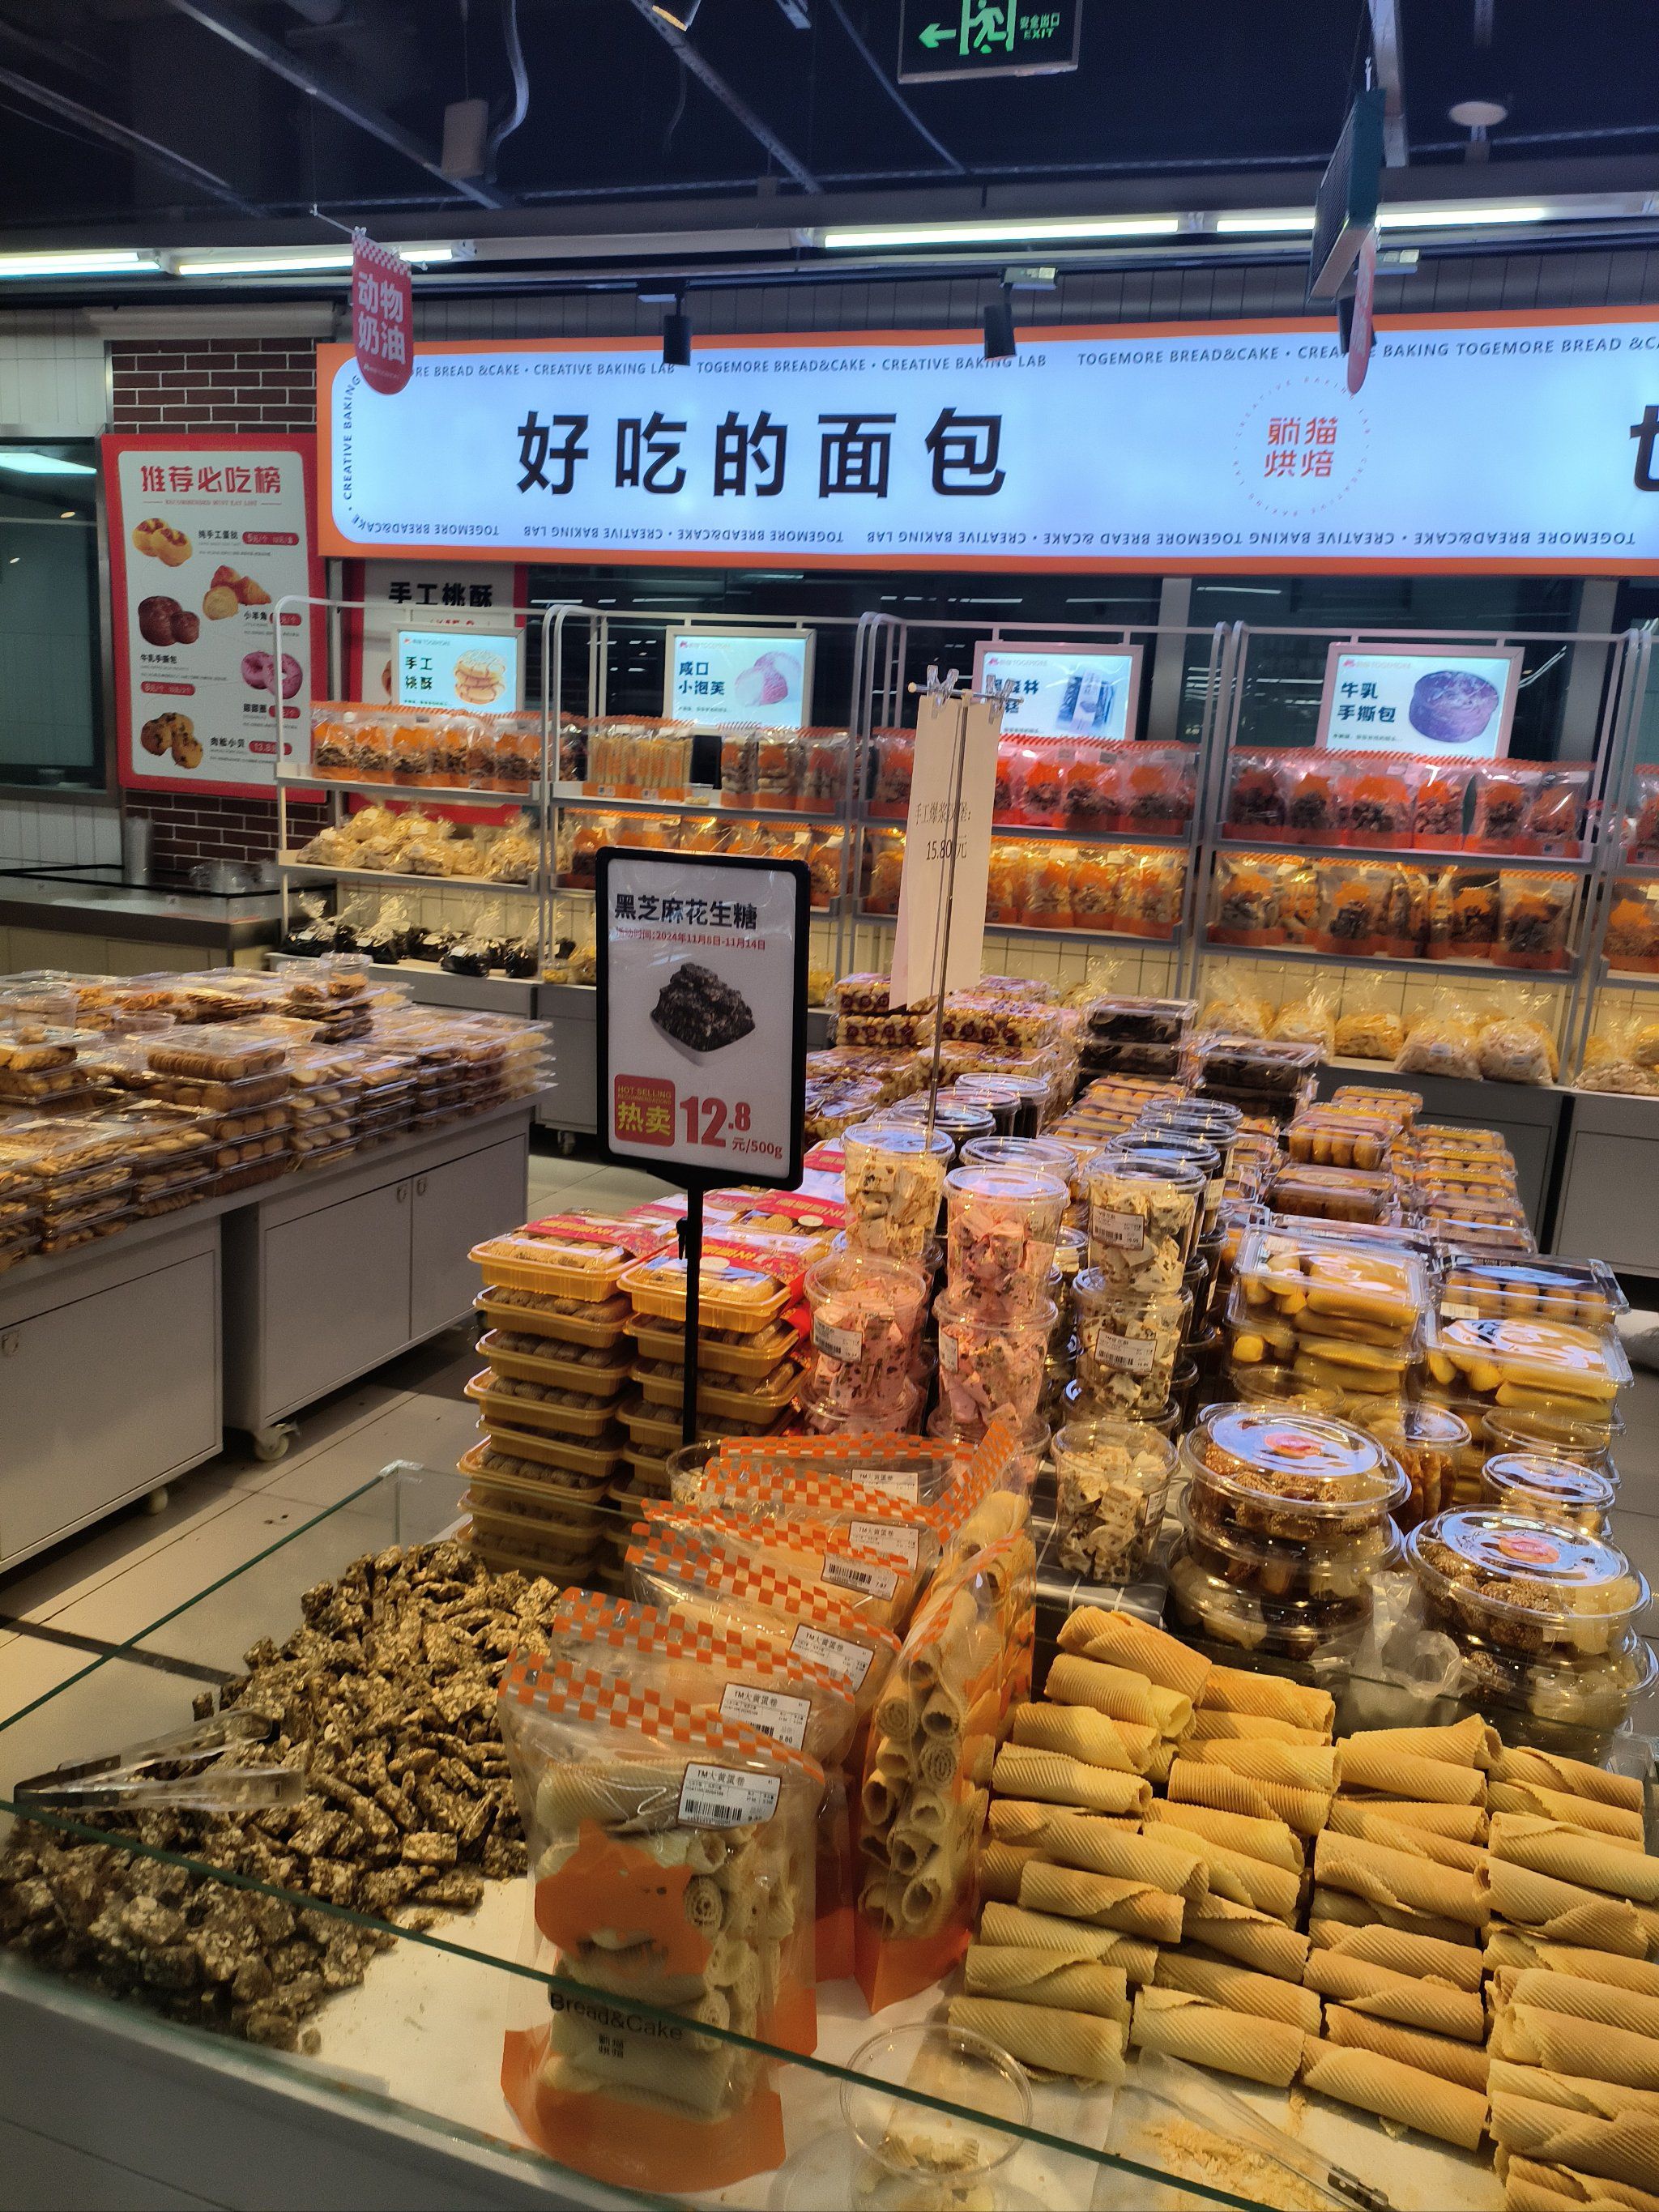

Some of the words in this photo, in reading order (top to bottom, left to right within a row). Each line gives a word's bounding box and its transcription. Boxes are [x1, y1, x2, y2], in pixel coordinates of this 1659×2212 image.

[1024, 28, 1055, 40] EXIT
[357, 271, 403, 323] 动物
[357, 314, 406, 365] 奶油
[1456, 339, 1555, 356] TOGEMORE
[1560, 337, 1622, 353] BREAD
[1077, 350, 1163, 365] TOGEMORE
[1169, 346, 1279, 363] BREAD&CAKE
[1383, 342, 1448, 358] BAKING
[433, 365, 474, 377] BREAD
[479, 364, 520, 376] &CAKE
[534, 363, 593, 376] CREATIVE
[597, 362, 646, 374] BAKING
[650, 363, 675, 374] LAB
[696, 360, 770, 373] TOGEMORE
[774, 359, 866, 373] BREAD&CAKE
[881, 357, 950, 371] CREATIVE
[1018, 355, 1047, 368] LAB
[343, 374, 361, 429] BAKING
[516, 407, 1006, 500] 好吃的面包
[343, 435, 352, 501] CREATIVE
[1264, 450, 1335, 478] 烘焙
[140, 466, 281, 493] 推荐必吃榜
[434, 523, 500, 536] TOGEMORE
[523, 525, 548, 537] LAB
[551, 526, 599, 539] BAKING
[603, 527, 663, 540] CREATIVE
[677, 528, 766, 542] BREAD&CAKE
[769, 530, 845, 543] TOGEMORE
[867, 531, 893, 543] LAB
[898, 531, 953, 543] BAKING
[958, 531, 1027, 544] CREATIVE
[1099, 532, 1150, 545] BREAD
[1156, 532, 1243, 545] TOGEMORE
[1248, 531, 1311, 545] BAKING
[1316, 531, 1395, 545] CREATIVE
[1414, 531, 1531, 545] BREAD&CAKE
[1537, 531, 1636, 545] TOGEMORE
[388, 582, 493, 607] 手工桃酥
[405, 656, 433, 671] 手工
[679, 680, 726, 696] 小泡芙
[1341, 682, 1379, 700] 牛乳
[1337, 705, 1397, 722] 手撕包
[615, 893, 757, 931] 黑芝麻花生糖
[618, 1085, 634, 1094] HOT
[638, 1087, 672, 1098] SELLING
[618, 1102, 671, 1136] 热卖
[680, 1096, 751, 1148] 12.8
[732, 1137, 783, 1159] 元/500g
[550, 1992, 683, 2041] Bread&Cake
